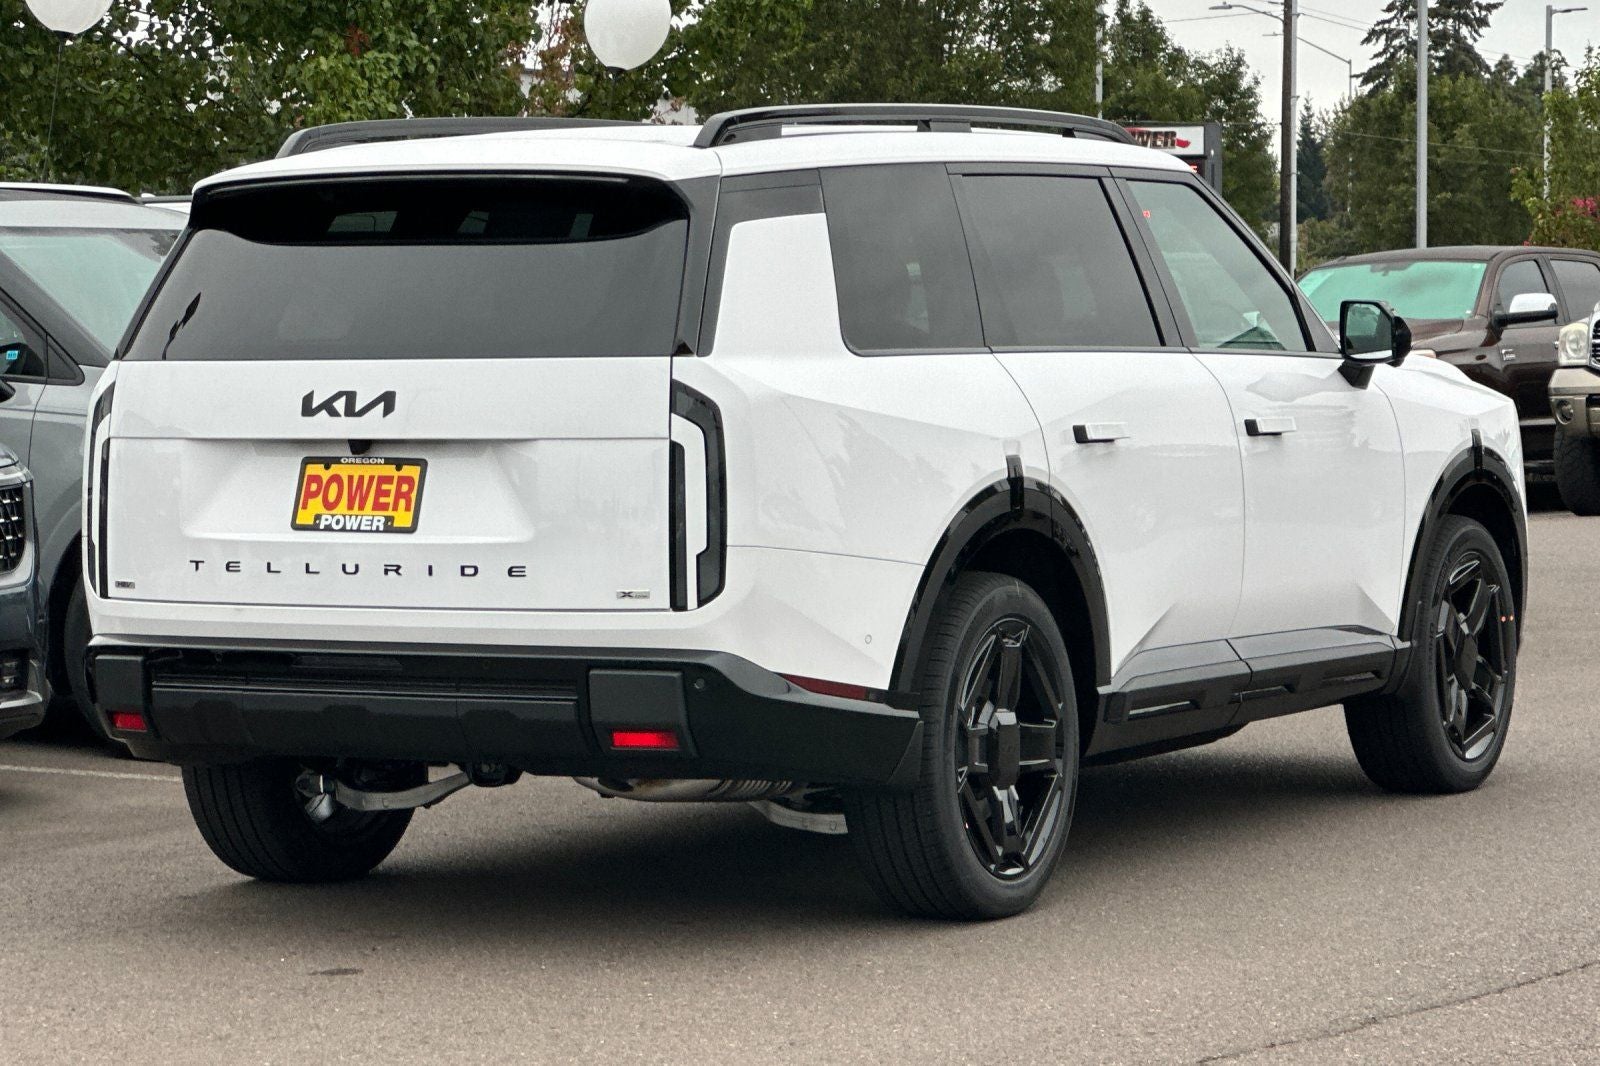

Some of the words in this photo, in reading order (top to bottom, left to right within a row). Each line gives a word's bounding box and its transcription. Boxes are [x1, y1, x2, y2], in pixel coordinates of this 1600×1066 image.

[1131, 130, 1177, 149] WER
[301, 389, 397, 418] KIA
[340, 457, 385, 465] OREGON
[300, 474, 416, 512] POWER
[318, 514, 386, 532] POWER
[189, 559, 528, 578] TELLURIDE
